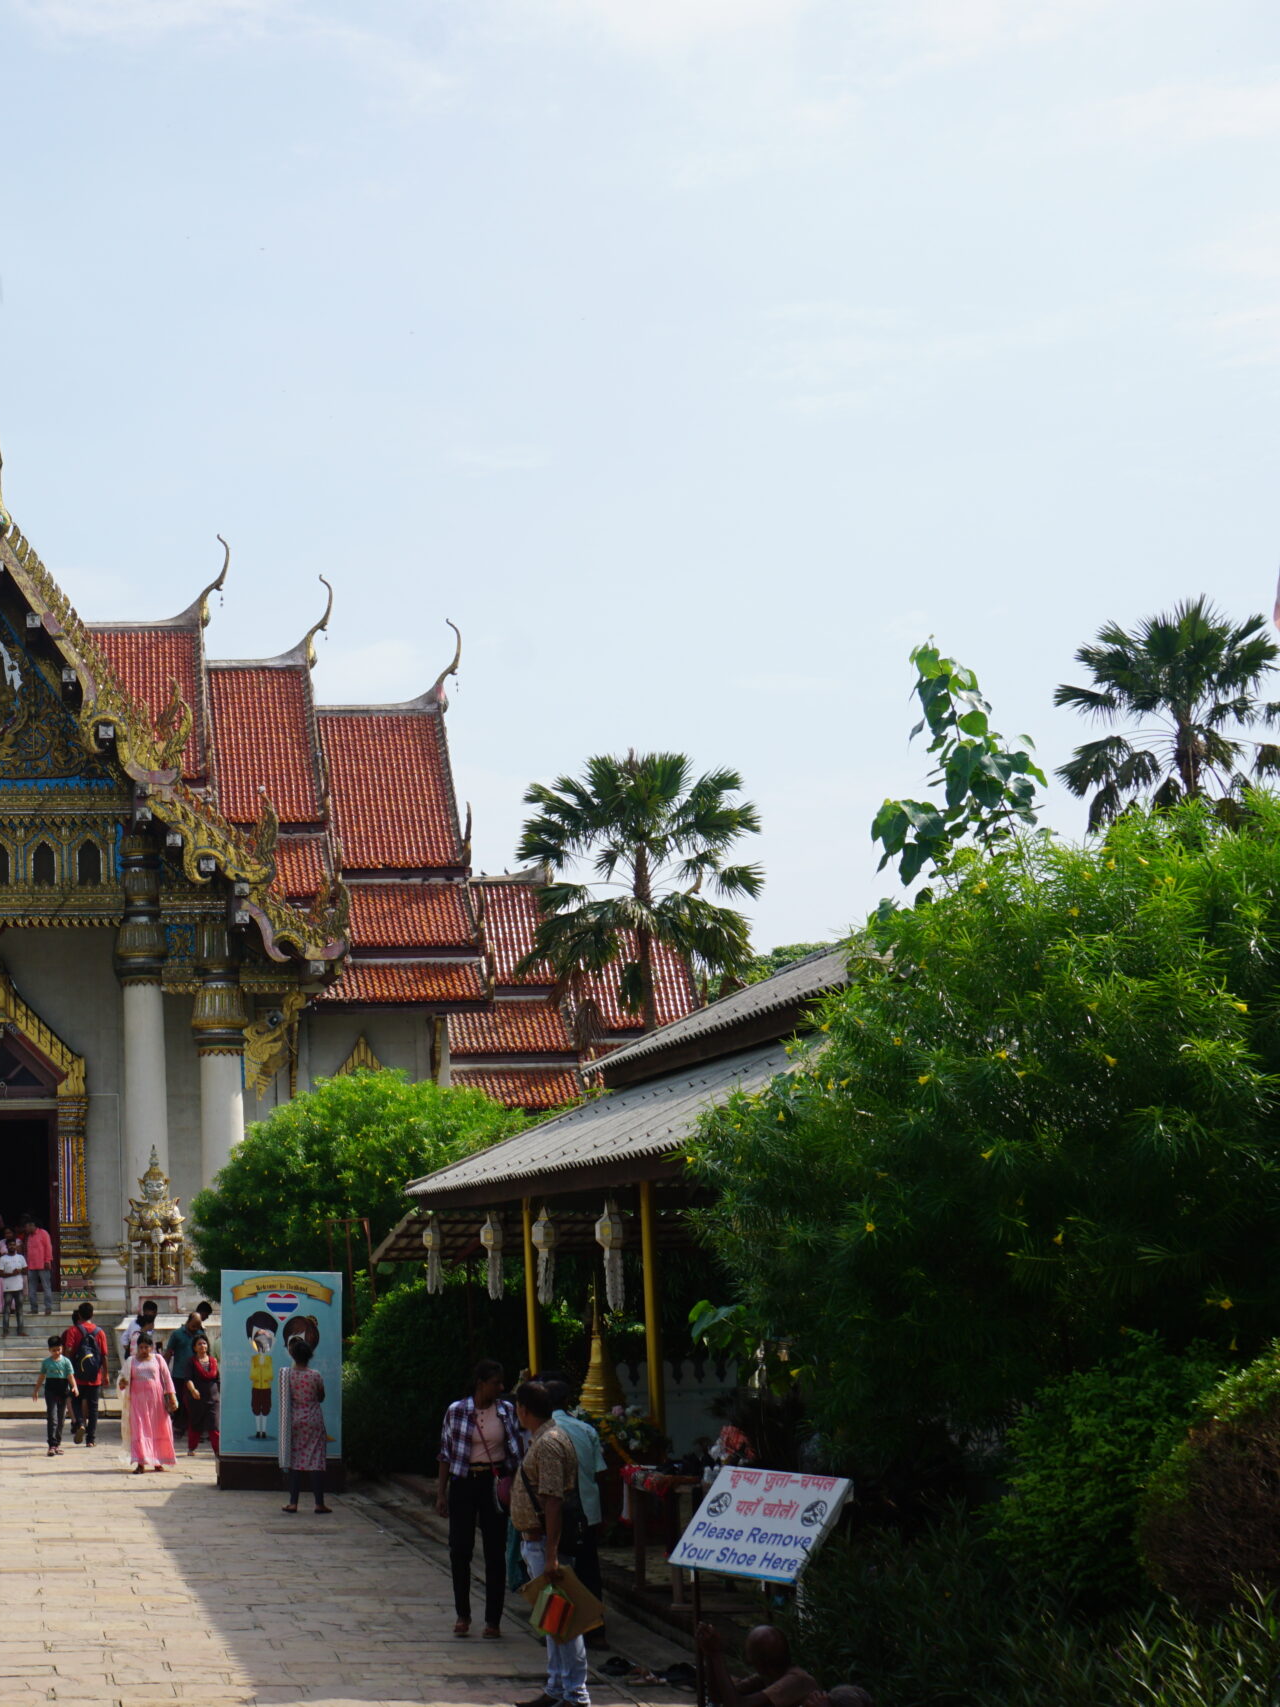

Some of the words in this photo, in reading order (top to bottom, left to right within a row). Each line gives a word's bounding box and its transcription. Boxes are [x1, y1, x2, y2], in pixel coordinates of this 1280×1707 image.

[692, 1521, 744, 1542] Please
[745, 1527, 812, 1548] Remove
[679, 1542, 715, 1561] Your
[716, 1547, 757, 1567] Shoe
